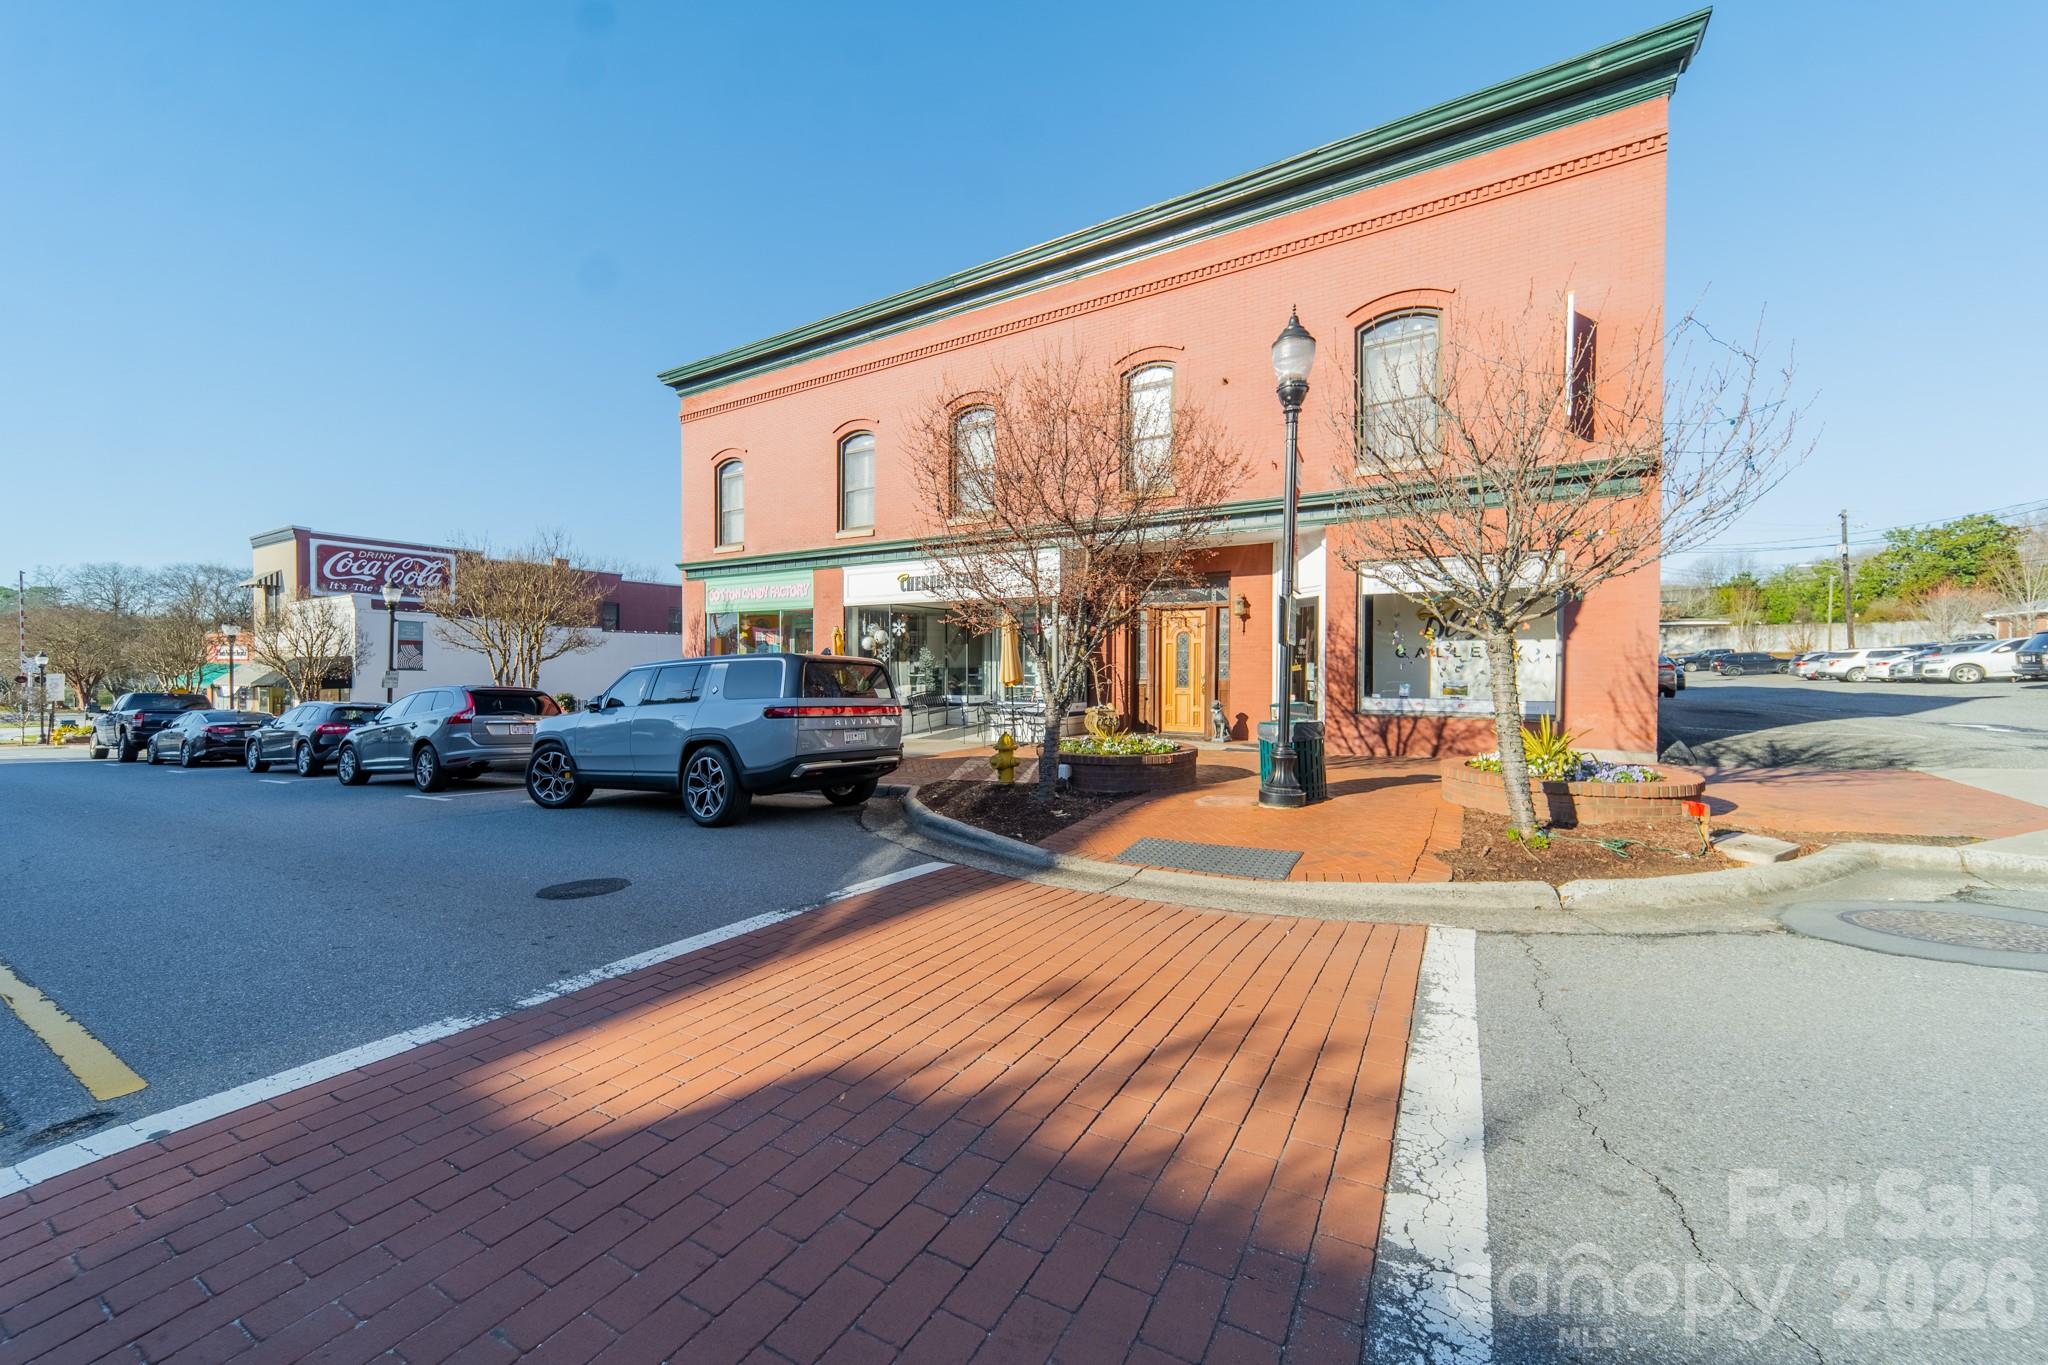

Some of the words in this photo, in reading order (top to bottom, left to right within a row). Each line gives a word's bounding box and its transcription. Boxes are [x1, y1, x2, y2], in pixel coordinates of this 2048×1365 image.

[358, 550, 396, 560] DRINK
[323, 551, 444, 587] Coca-Cola
[329, 581, 347, 590] It's
[353, 583, 373, 592] The
[709, 586, 741, 602] COTTON
[742, 585, 768, 599] CANDY
[770, 583, 810, 599] FACTORY
[835, 718, 880, 726] RIVIAN
